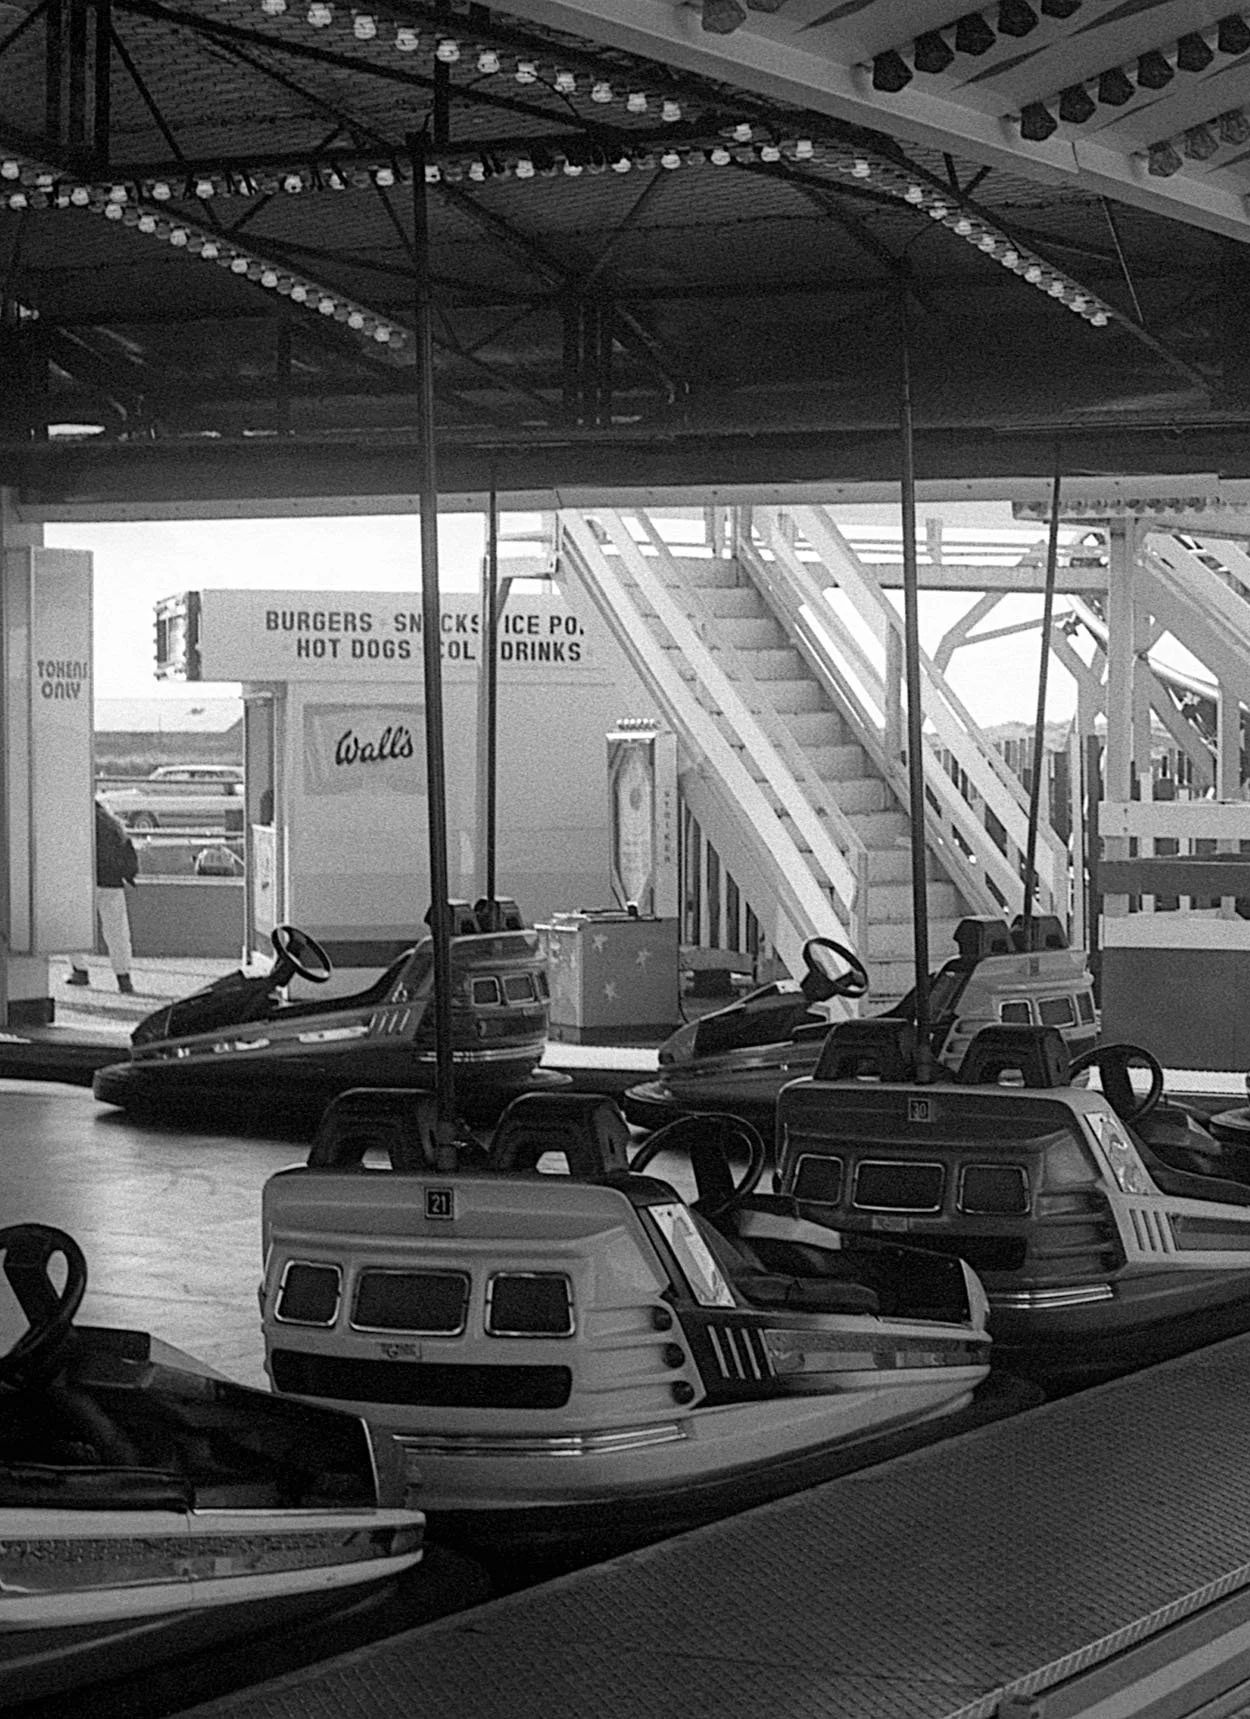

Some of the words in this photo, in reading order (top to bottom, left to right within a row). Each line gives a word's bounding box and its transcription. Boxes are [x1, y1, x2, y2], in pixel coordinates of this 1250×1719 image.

[266, 611, 372, 632] BURGERS
[394, 612, 479, 633] SNCKS
[504, 614, 540, 635] ICE
[297, 638, 341, 659] HOT
[351, 639, 411, 660] DOGS
[501, 641, 581, 662] DRINKS
[37, 660, 89, 678] TOKENS
[41, 681, 81, 699] ONLY
[335, 726, 414, 766] Wall's
[431, 1194, 446, 1213] 21
